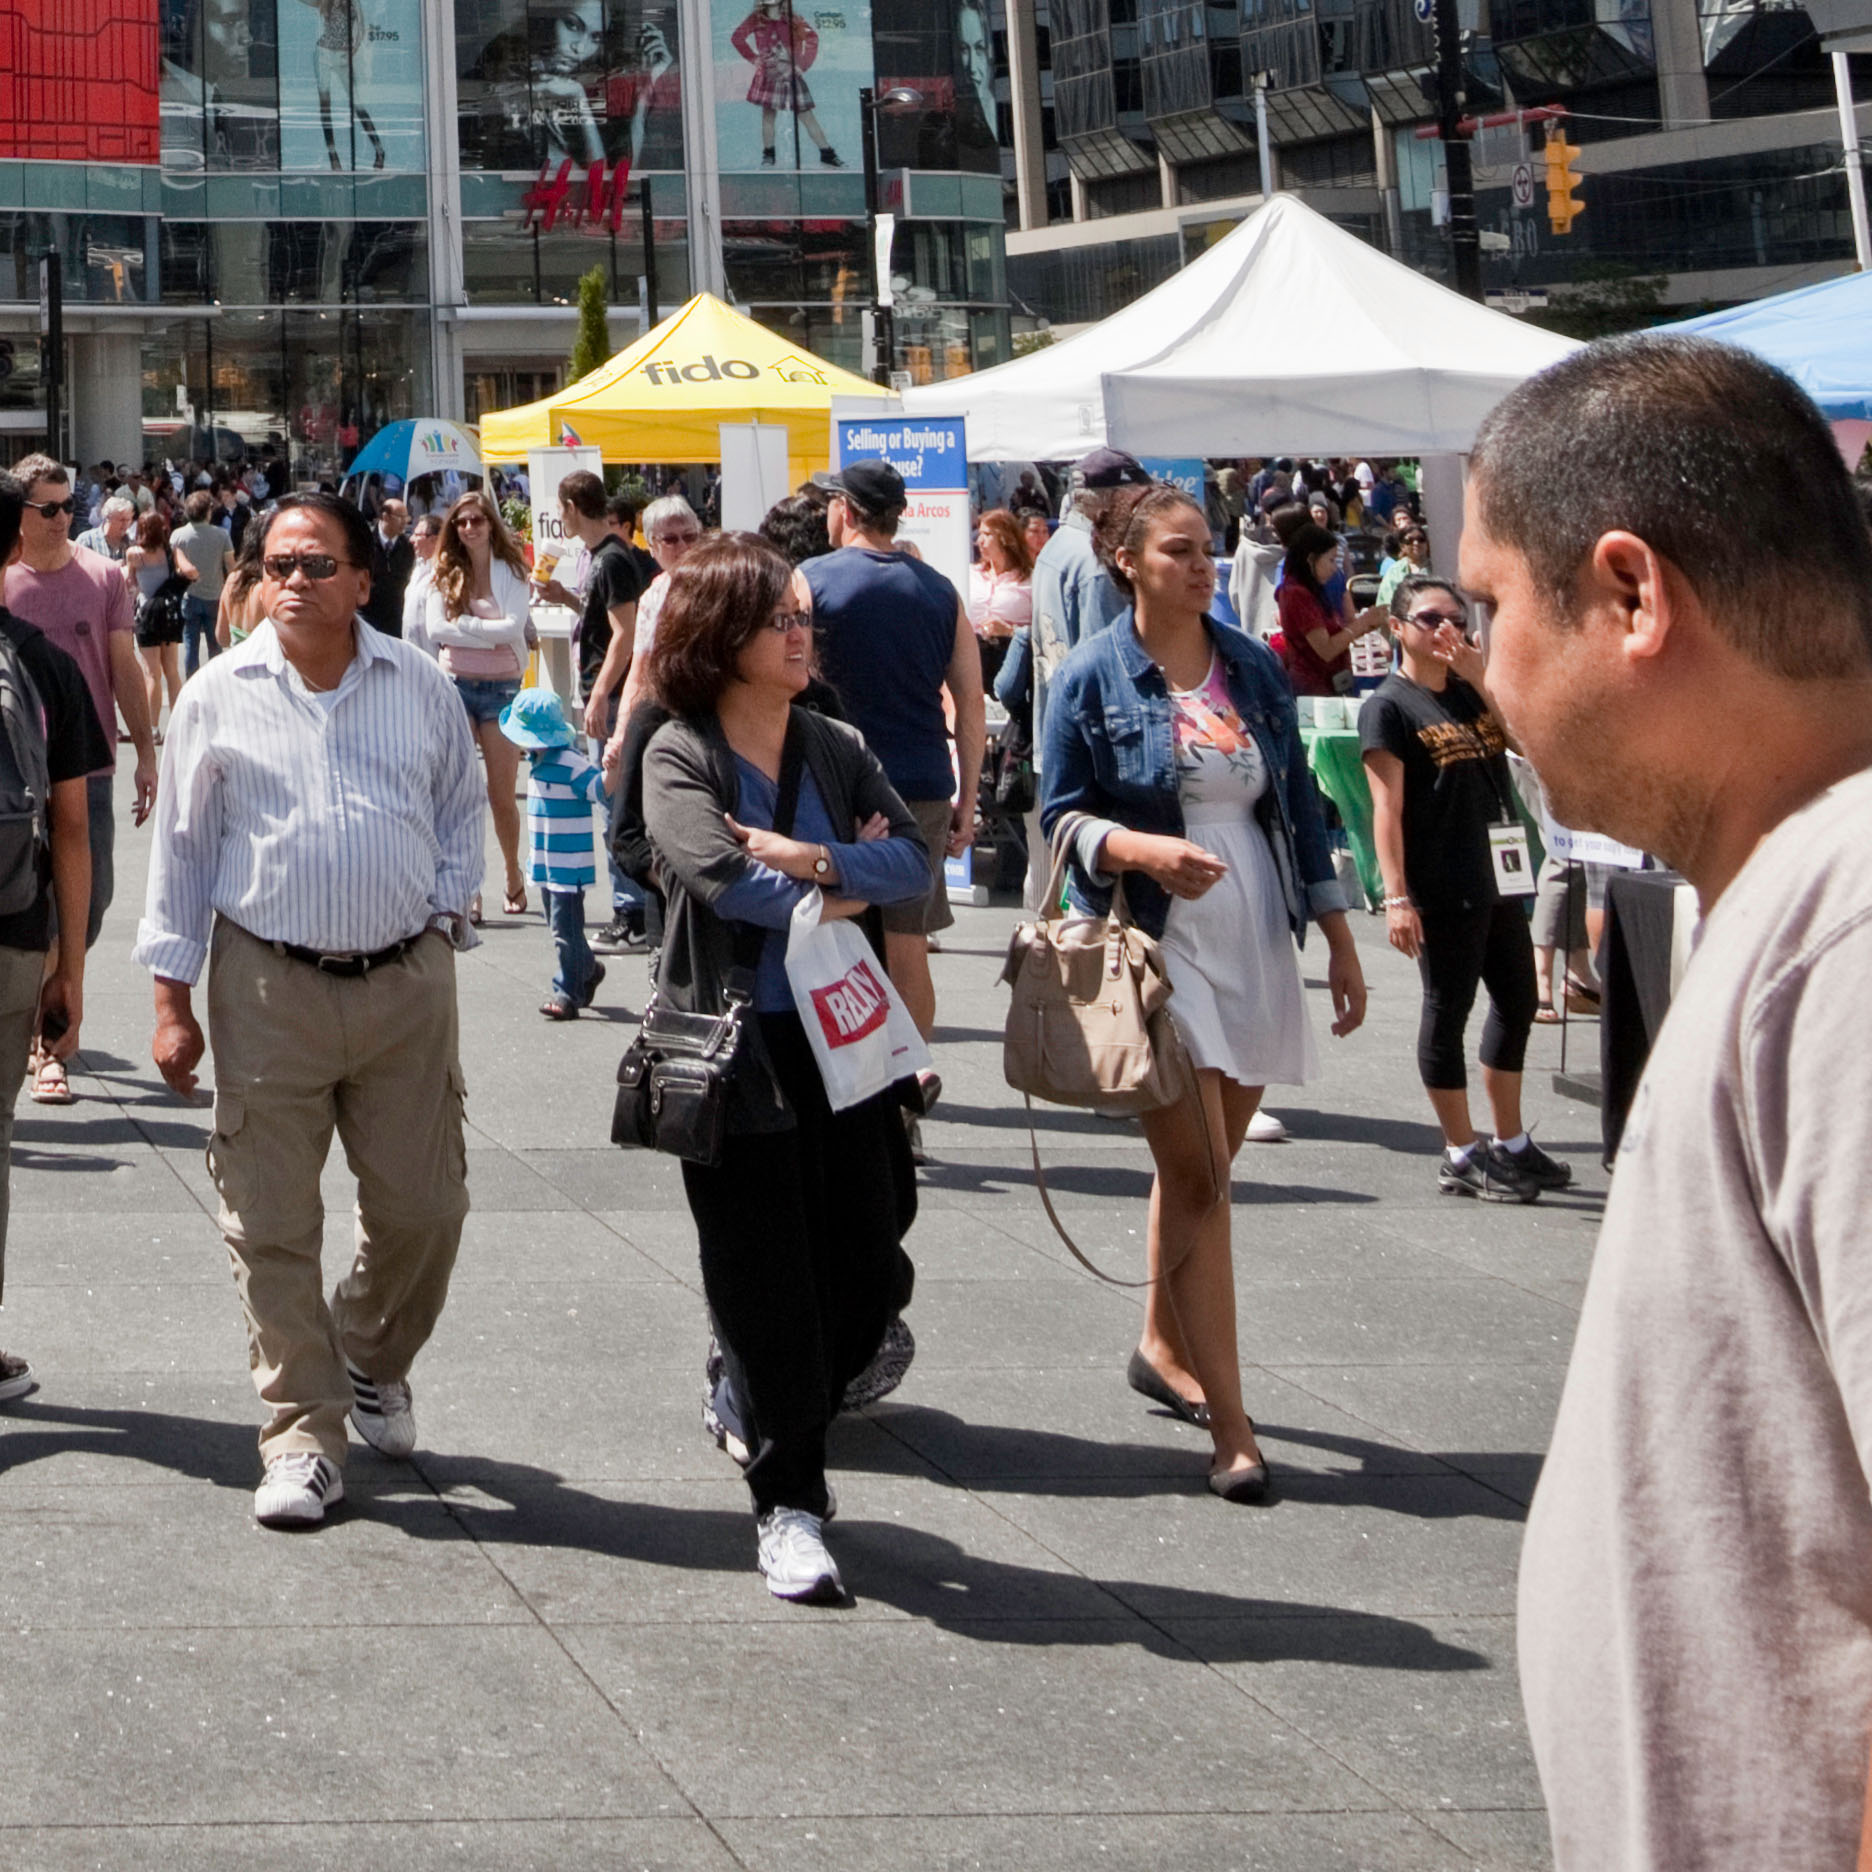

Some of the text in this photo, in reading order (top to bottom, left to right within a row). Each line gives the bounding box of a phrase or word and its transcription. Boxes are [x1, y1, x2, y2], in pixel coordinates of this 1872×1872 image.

[522, 159, 632, 223] H&M
[640, 355, 760, 385] fido
[847, 427, 956, 455] Selling or Buying a
[917, 503, 950, 518] Arcos
